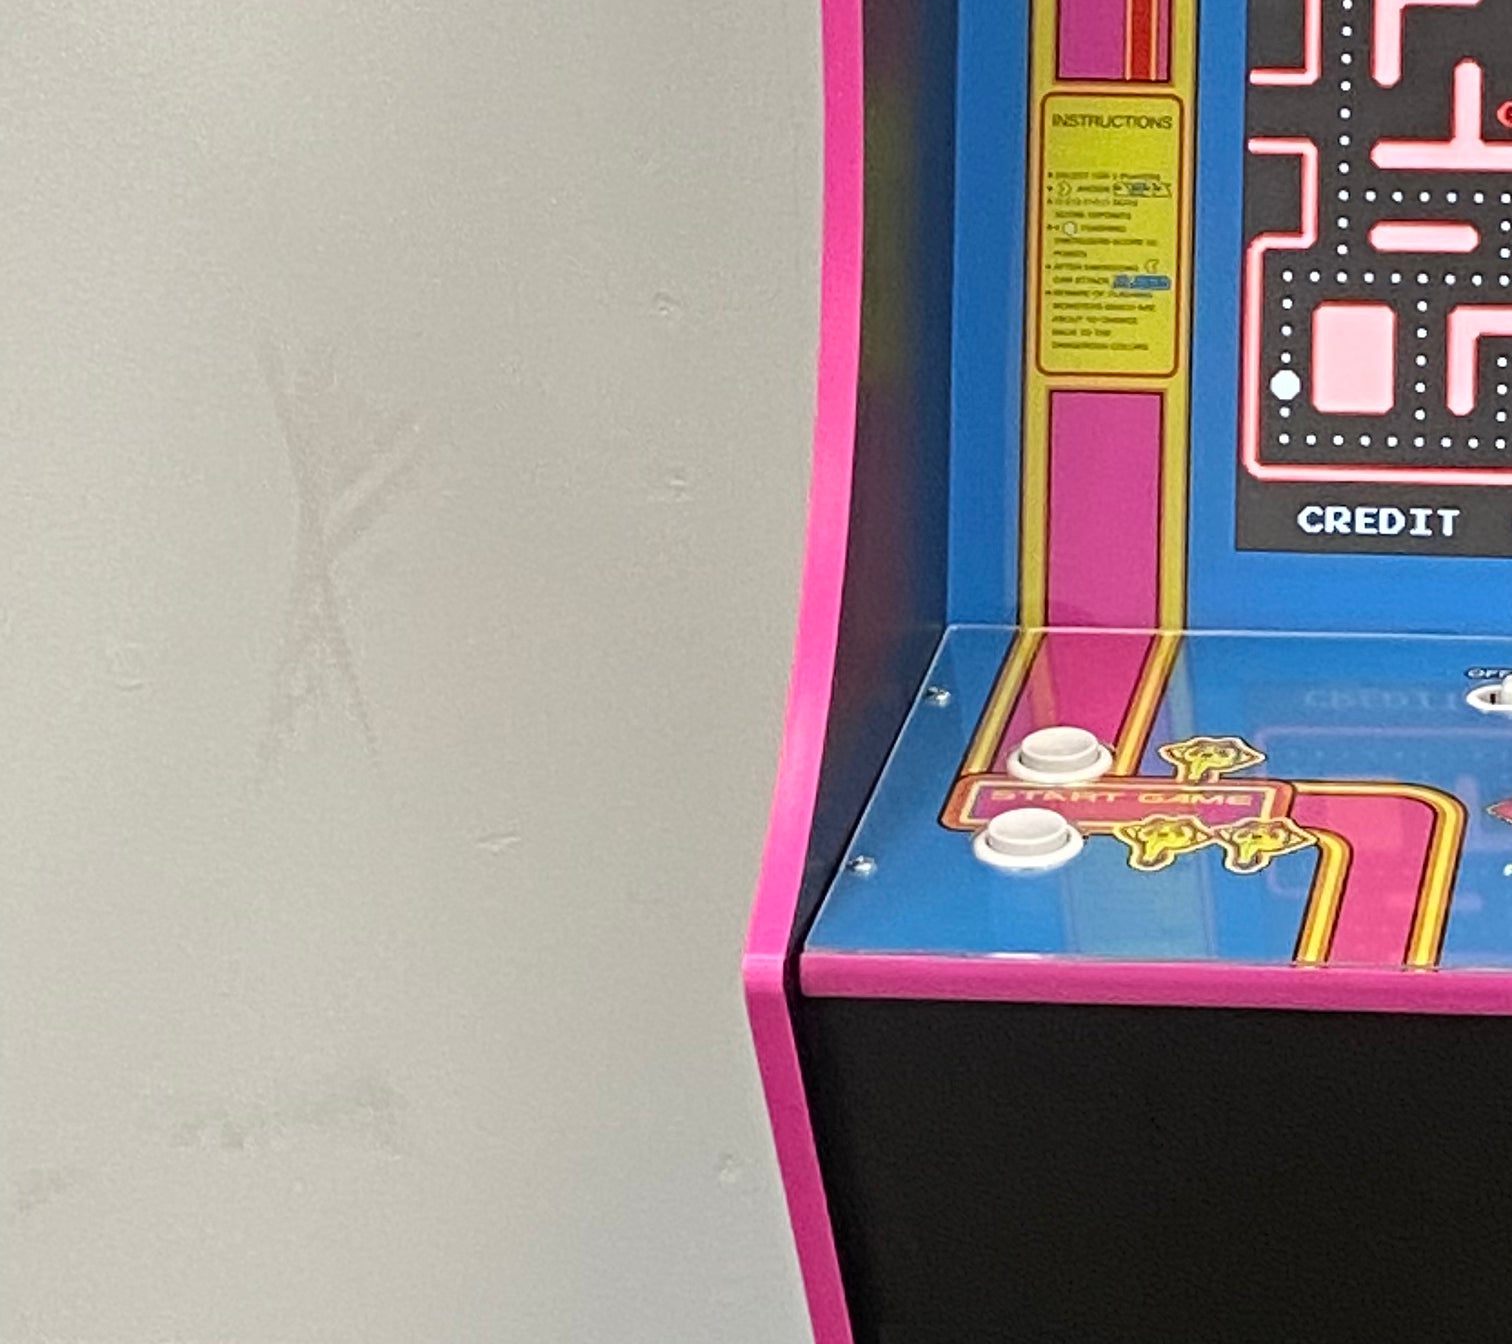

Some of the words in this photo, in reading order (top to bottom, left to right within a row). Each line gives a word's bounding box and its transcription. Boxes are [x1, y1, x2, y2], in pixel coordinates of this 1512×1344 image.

[1051, 113, 1174, 130] INSTRUCTIONS
[1297, 505, 1460, 537] CREDIT
[990, 789, 1126, 803] START
[1136, 792, 1253, 806] GAME
